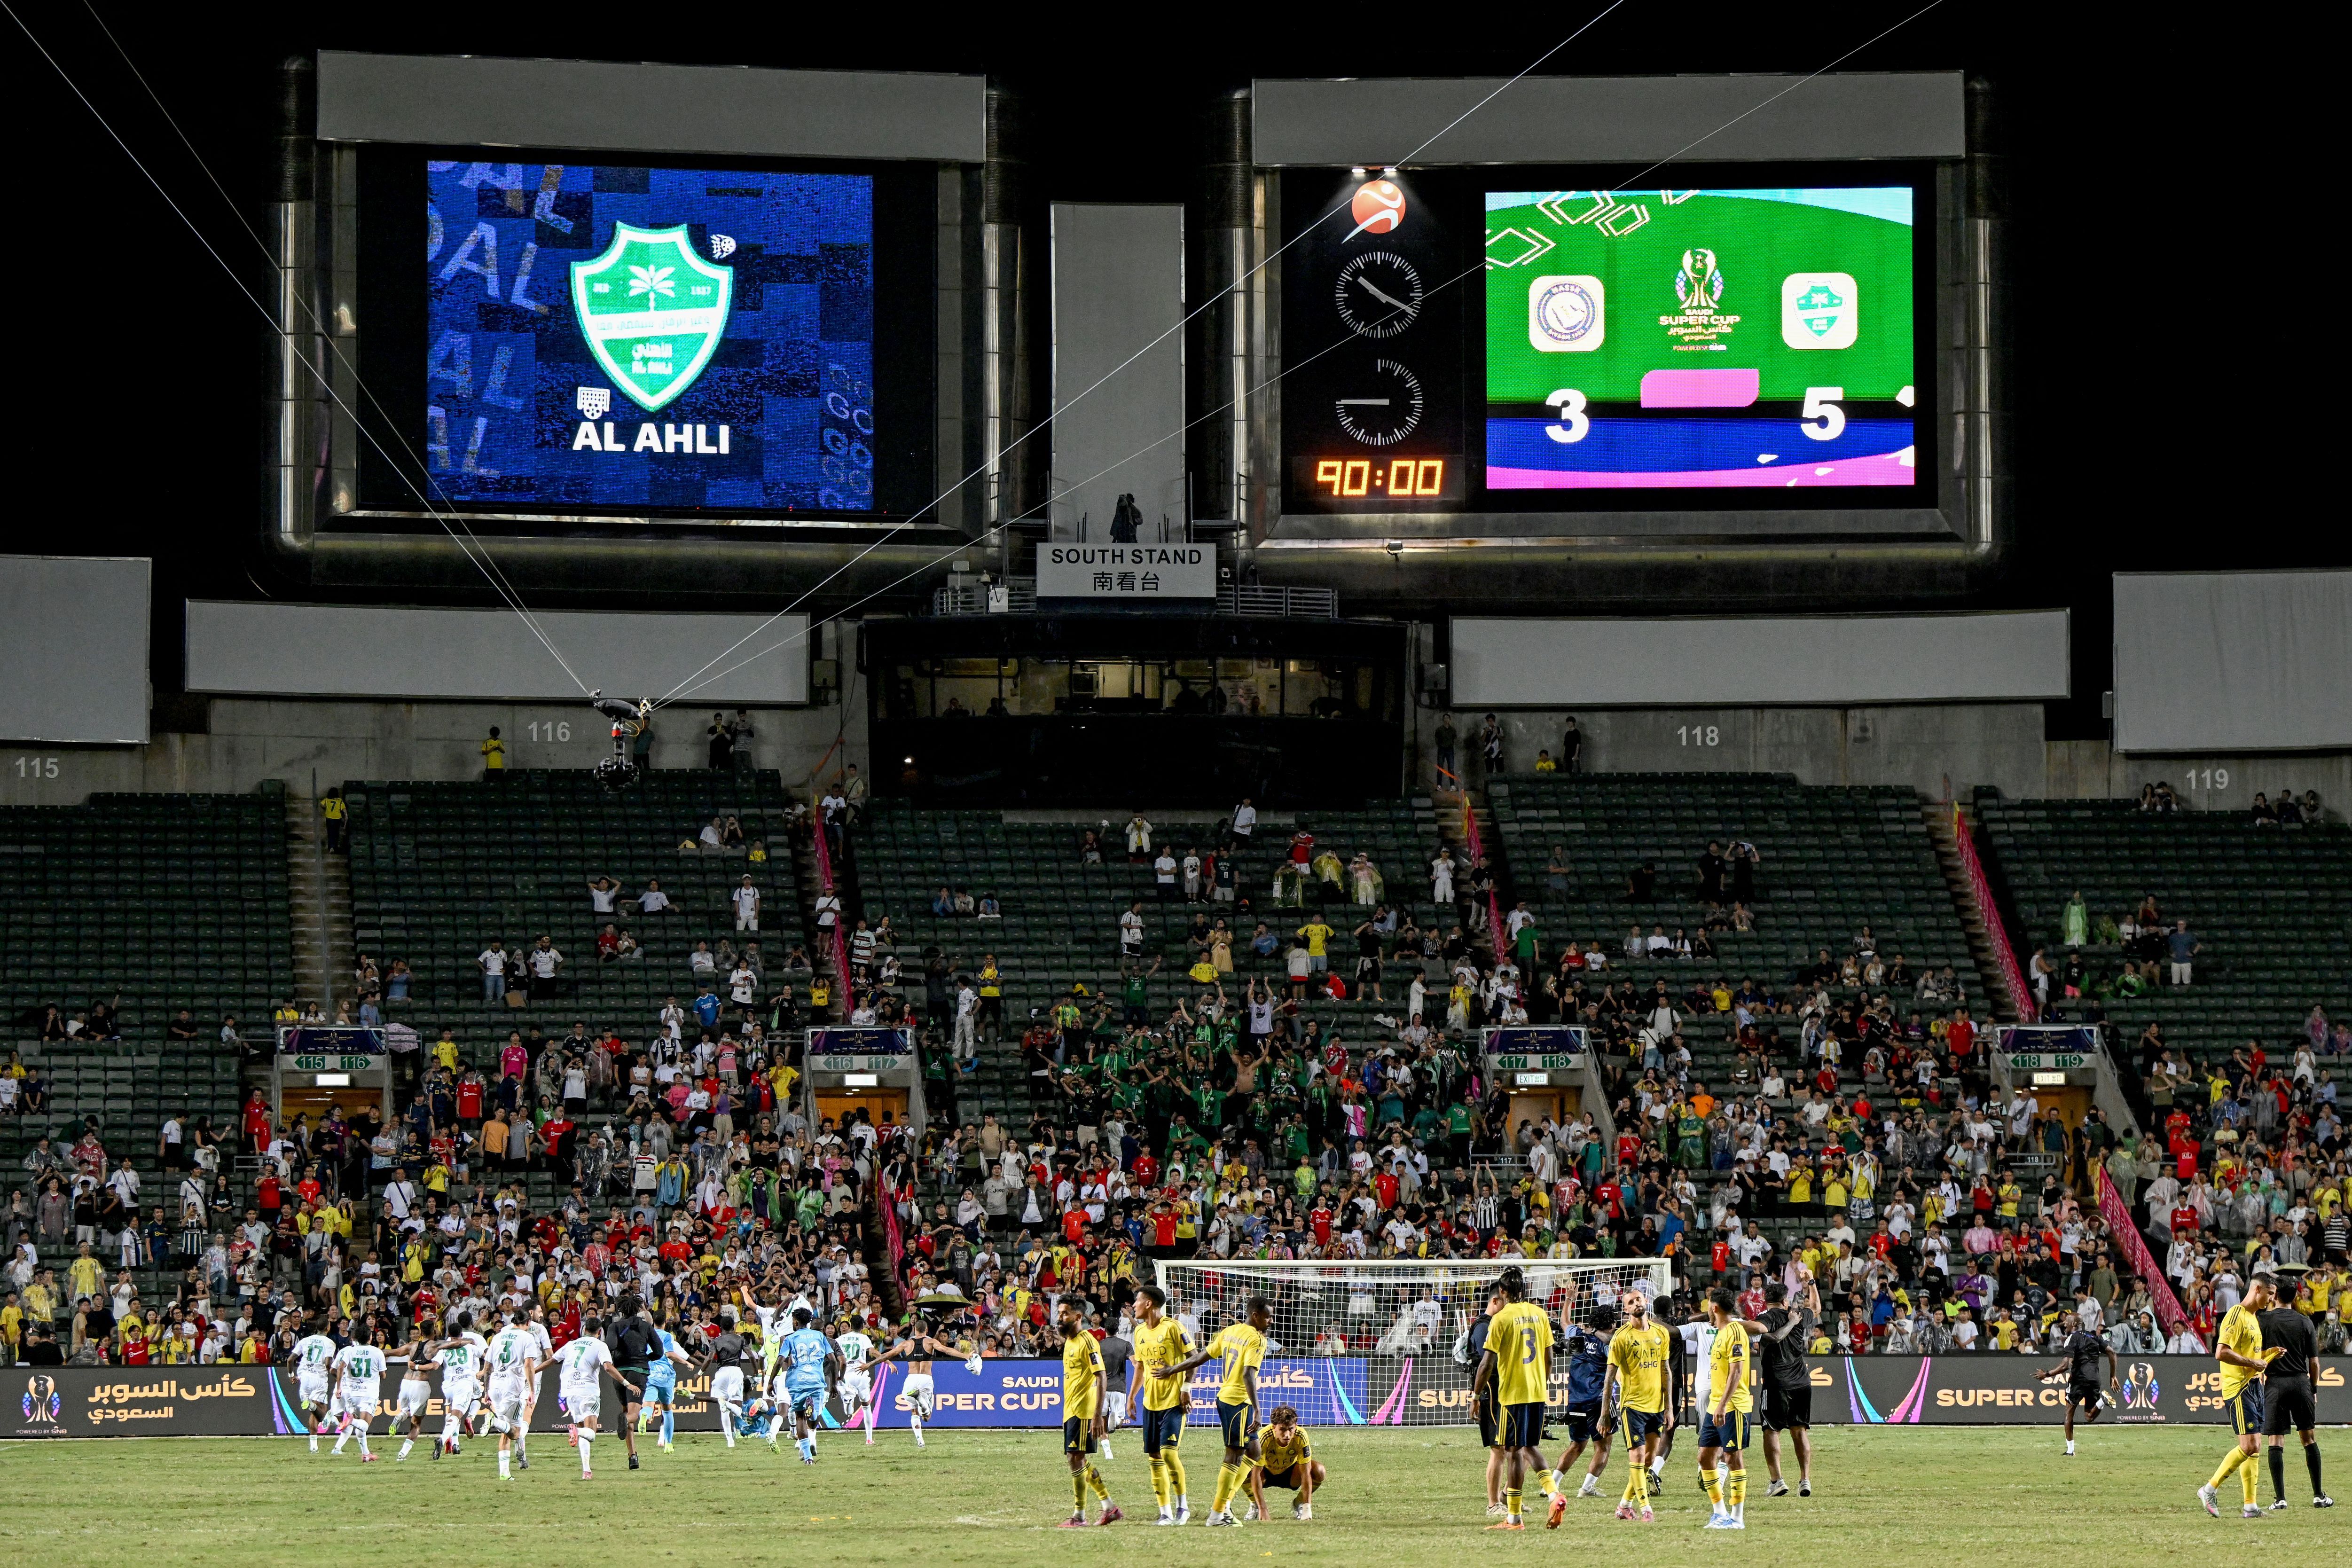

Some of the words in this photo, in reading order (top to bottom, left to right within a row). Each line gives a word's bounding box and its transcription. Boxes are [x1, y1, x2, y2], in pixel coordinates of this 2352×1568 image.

[1659, 315, 1709, 325] SUPER
[1710, 315, 1741, 325] CUP
[1667, 325, 1702, 336] السوبر
[1702, 323, 1733, 335] كأس
[1545, 389, 1589, 443] 3
[1801, 387, 1845, 441] 5
[572, 422, 626, 451] AL
[633, 423, 729, 454] AHLI
[1317, 460, 1443, 495] 90:00
[1051, 548, 1124, 564] SOUTH
[1130, 549, 1202, 564] STAND
[1093, 571, 1160, 592] 南看台
[528, 721, 570, 742] 116
[1677, 726, 1719, 746] 118
[15, 756, 59, 778] 115
[2186, 768, 2228, 790] 119
[330, 801, 337, 812] 7
[300, 1056, 323, 1069] 115
[342, 1057, 366, 1069] 116
[828, 1057, 851, 1069] 116
[870, 1057, 892, 1069] 117
[1503, 1056, 1524, 1068] 117
[1544, 1056, 1567, 1068] 118
[2015, 1055, 2038, 1067] 118
[2057, 1056, 2079, 1067] 119
[882, 1131, 890, 1144] 7
[1560, 1187, 1570, 1203] 7
[1716, 1250, 1721, 1261] 7
[500, 1332, 518, 1341] IBAÑEZ
[306, 1344, 324, 1363] 17
[499, 1340, 512, 1364] 3
[795, 1340, 820, 1363] 62
[841, 1343, 860, 1360] 30
[1140, 1346, 1167, 1356] KAFD
[1520, 1328, 1537, 1365] 3
[444, 1347, 468, 1367] 29
[574, 1347, 586, 1368] 7
[350, 1358, 372, 1379] 31
[180, 1374, 255, 1401] كأس
[1003, 1377, 1059, 1388] SAUDI
[88, 1380, 176, 1404] السوبر
[1419, 1390, 1474, 1407] SUP
[1936, 1389, 2034, 1407] SUPER
[895, 1393, 996, 1411] SPER
[1000, 1393, 1061, 1410] CUP
[88, 1406, 173, 1424] السعودي
